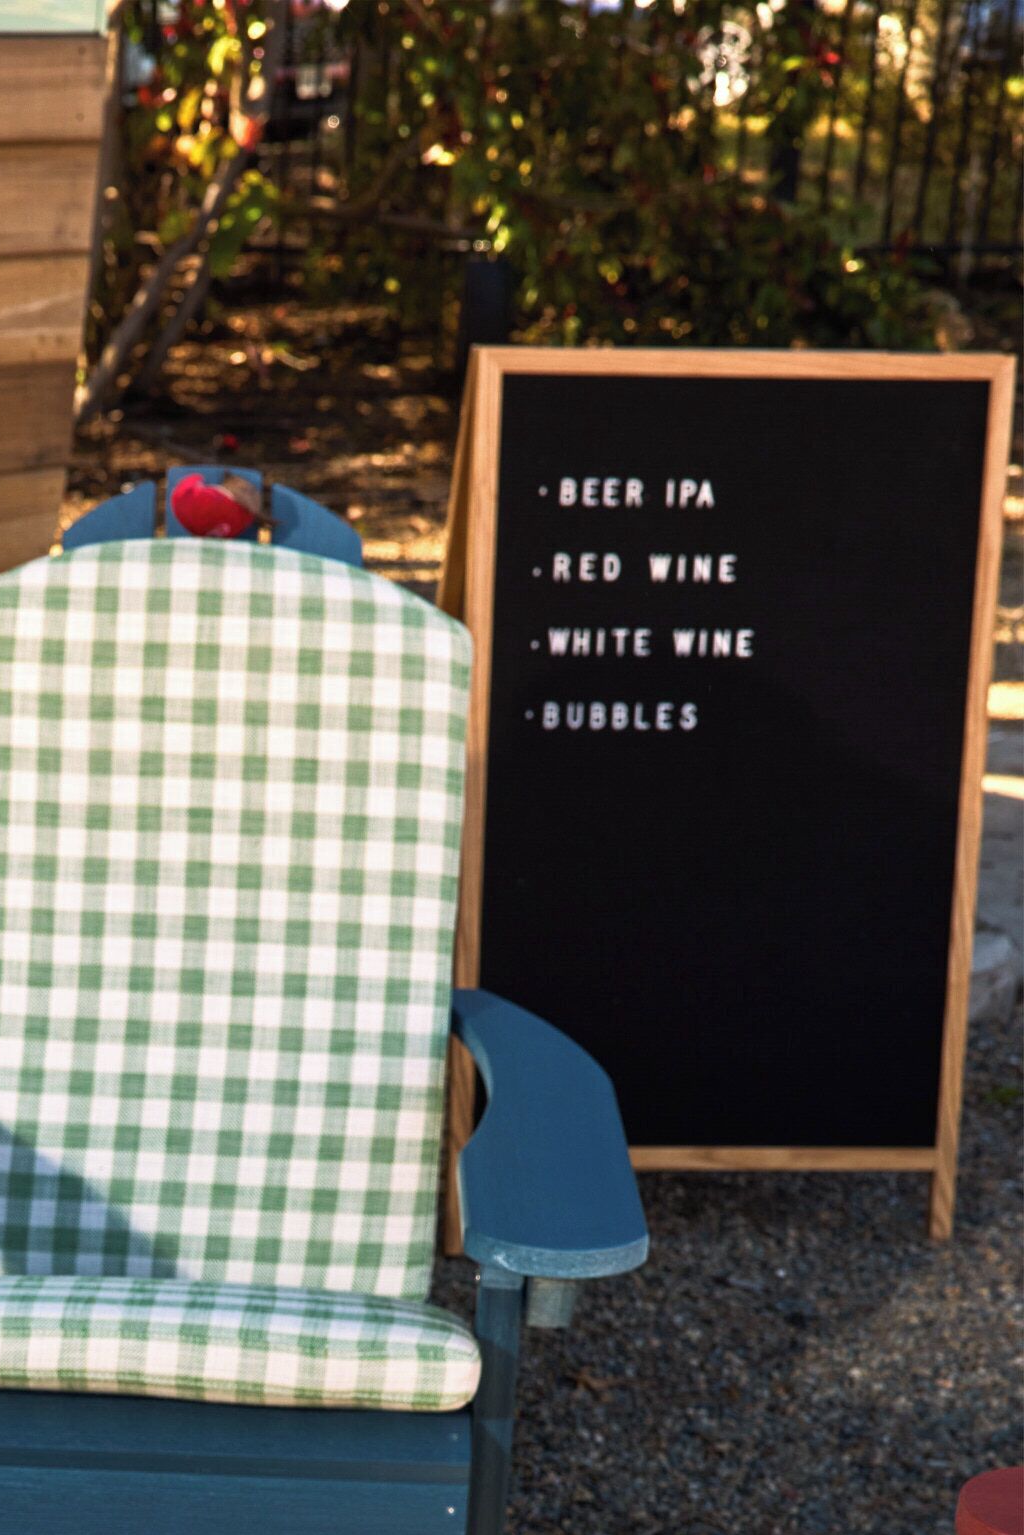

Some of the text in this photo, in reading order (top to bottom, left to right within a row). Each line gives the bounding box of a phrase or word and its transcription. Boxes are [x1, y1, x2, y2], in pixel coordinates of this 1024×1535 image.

[559, 477, 715, 508] BEER IPA
[552, 552, 737, 583] RED WINE
[548, 627, 754, 658] WHITE WINE
[542, 701, 698, 731] BUBBLES
